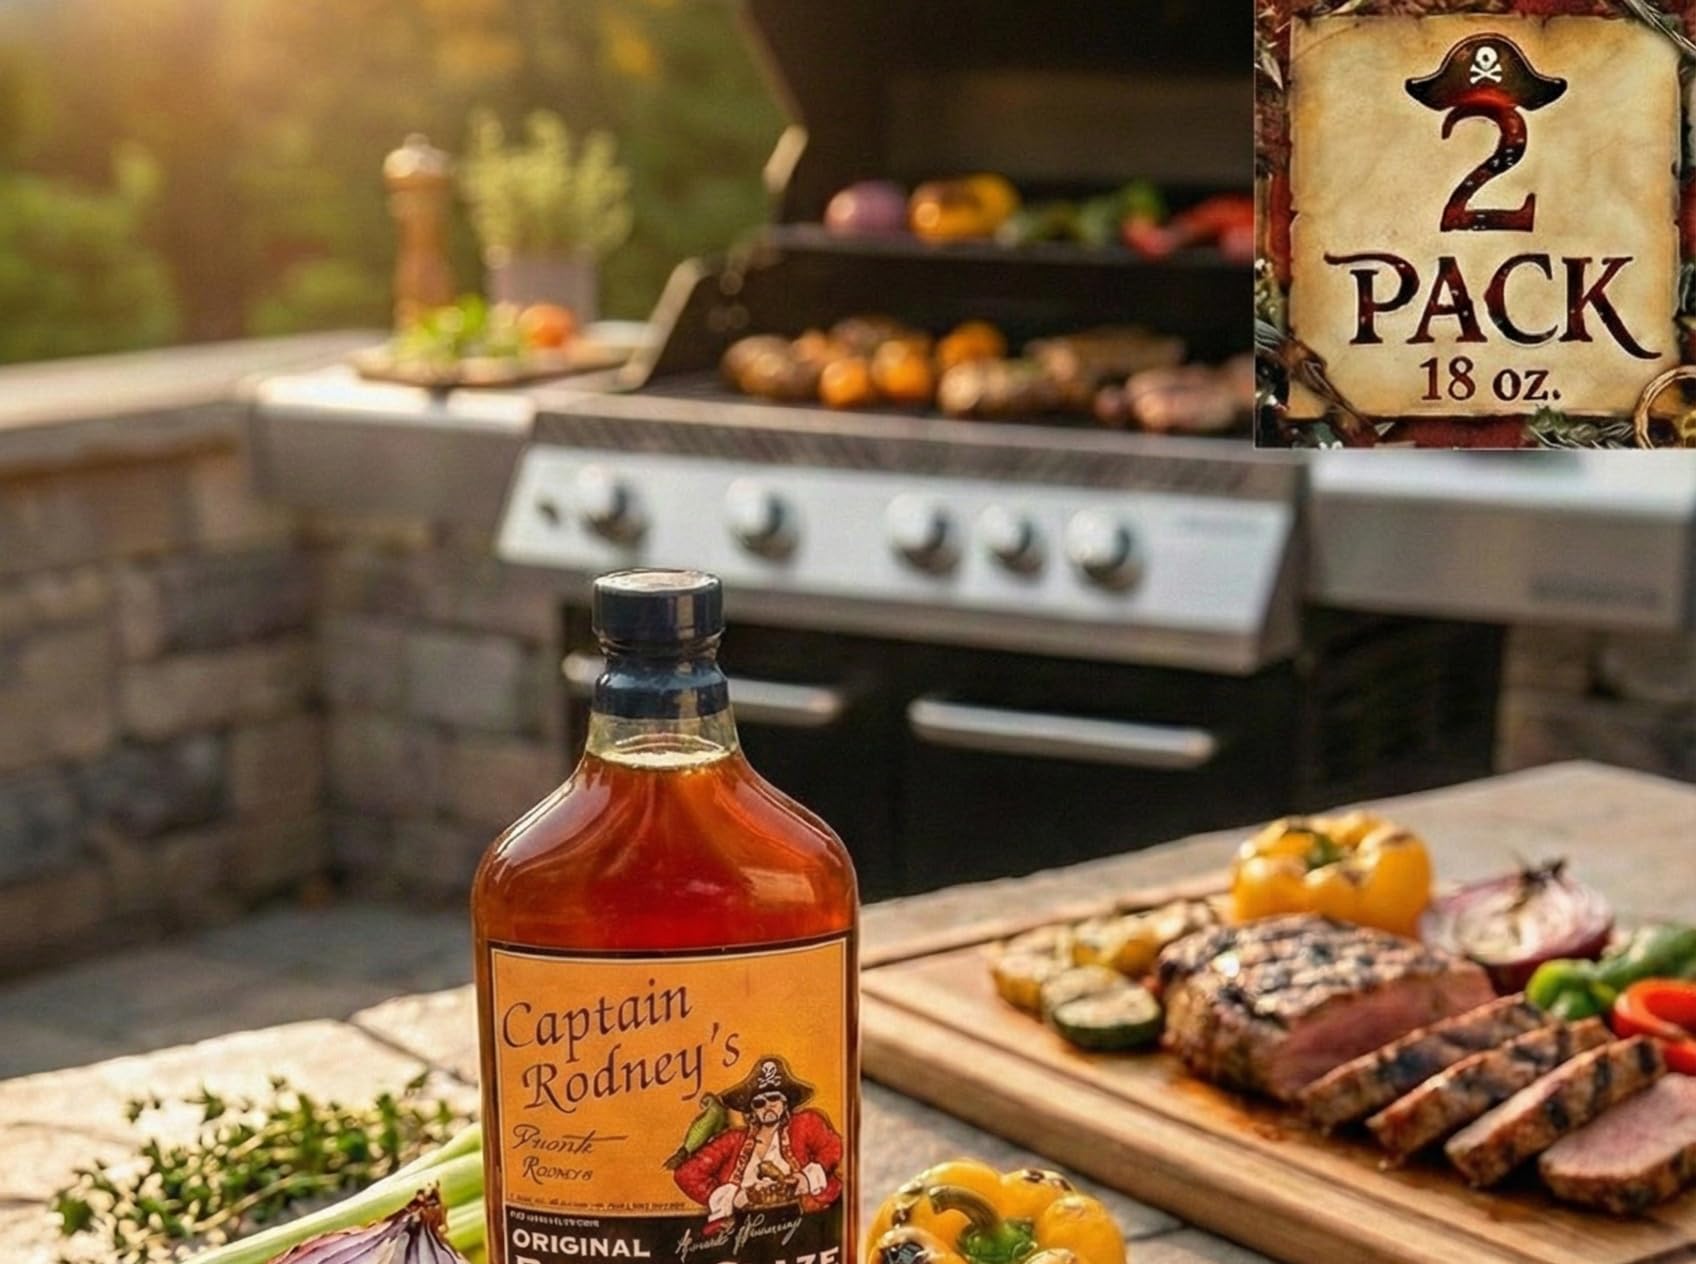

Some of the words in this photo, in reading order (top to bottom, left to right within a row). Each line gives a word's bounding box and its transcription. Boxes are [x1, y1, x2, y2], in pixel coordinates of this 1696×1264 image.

[503, 978, 692, 1063] Captain
[522, 1022, 740, 1114] Rodney's
[512, 1228, 651, 1257] ORIGINAL
